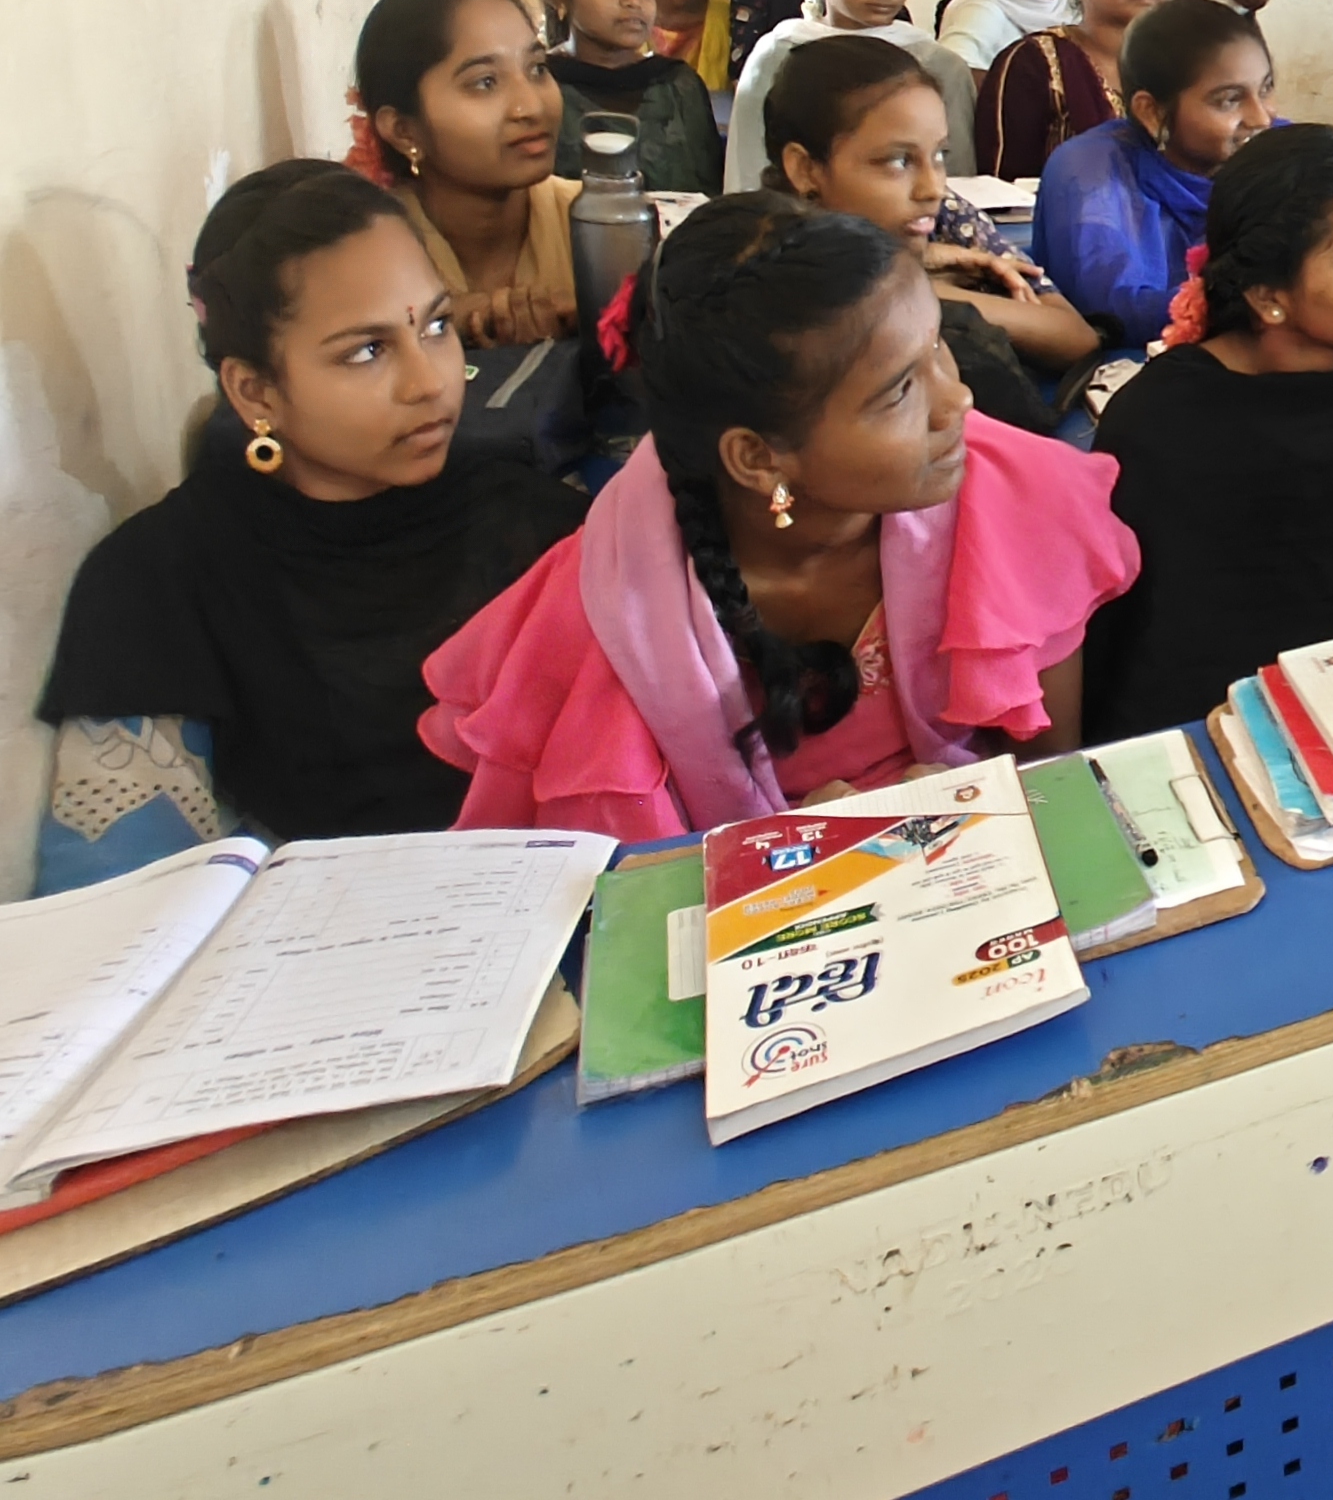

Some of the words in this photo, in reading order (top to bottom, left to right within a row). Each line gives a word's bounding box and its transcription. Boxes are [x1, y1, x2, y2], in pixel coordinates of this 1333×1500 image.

[773, 851, 812, 871] 17
[987, 933, 1040, 959] 100
[1010, 950, 1035, 966] AP
[956, 961, 1001, 984] 2025
[738, 951, 882, 1029] हिंदी
[790, 1051, 829, 1073] sure
